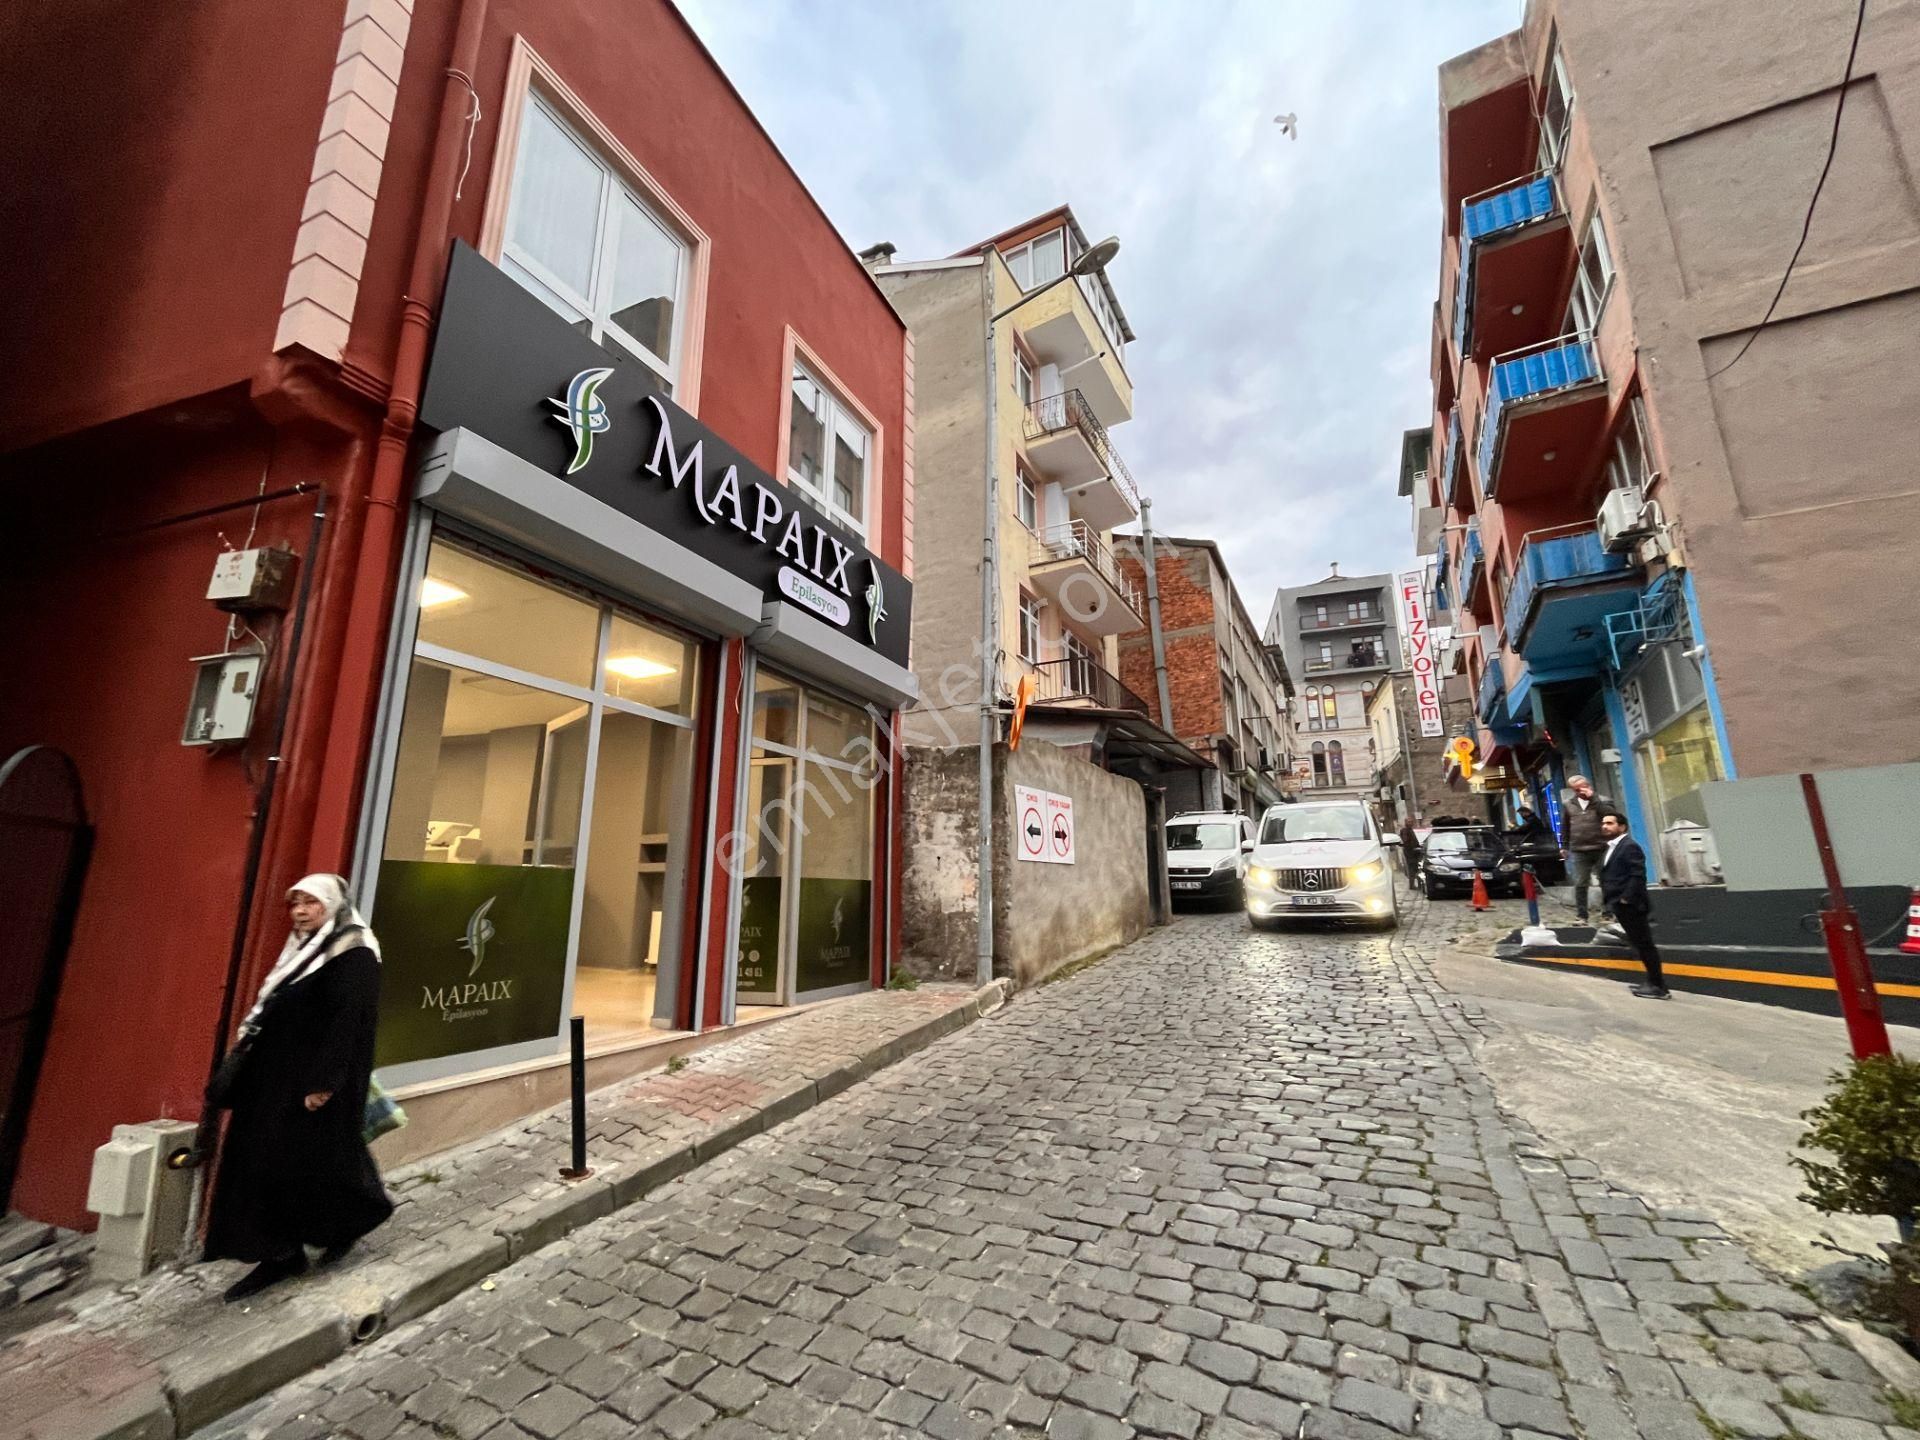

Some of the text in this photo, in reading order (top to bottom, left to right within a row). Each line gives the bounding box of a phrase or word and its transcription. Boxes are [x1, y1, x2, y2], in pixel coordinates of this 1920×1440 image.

[644, 395, 853, 597] MAPAIX
[791, 576, 839, 617] Epilasyon
[421, 980, 513, 1010] MAPAIX
[442, 1008, 489, 1023] Epilasyon
